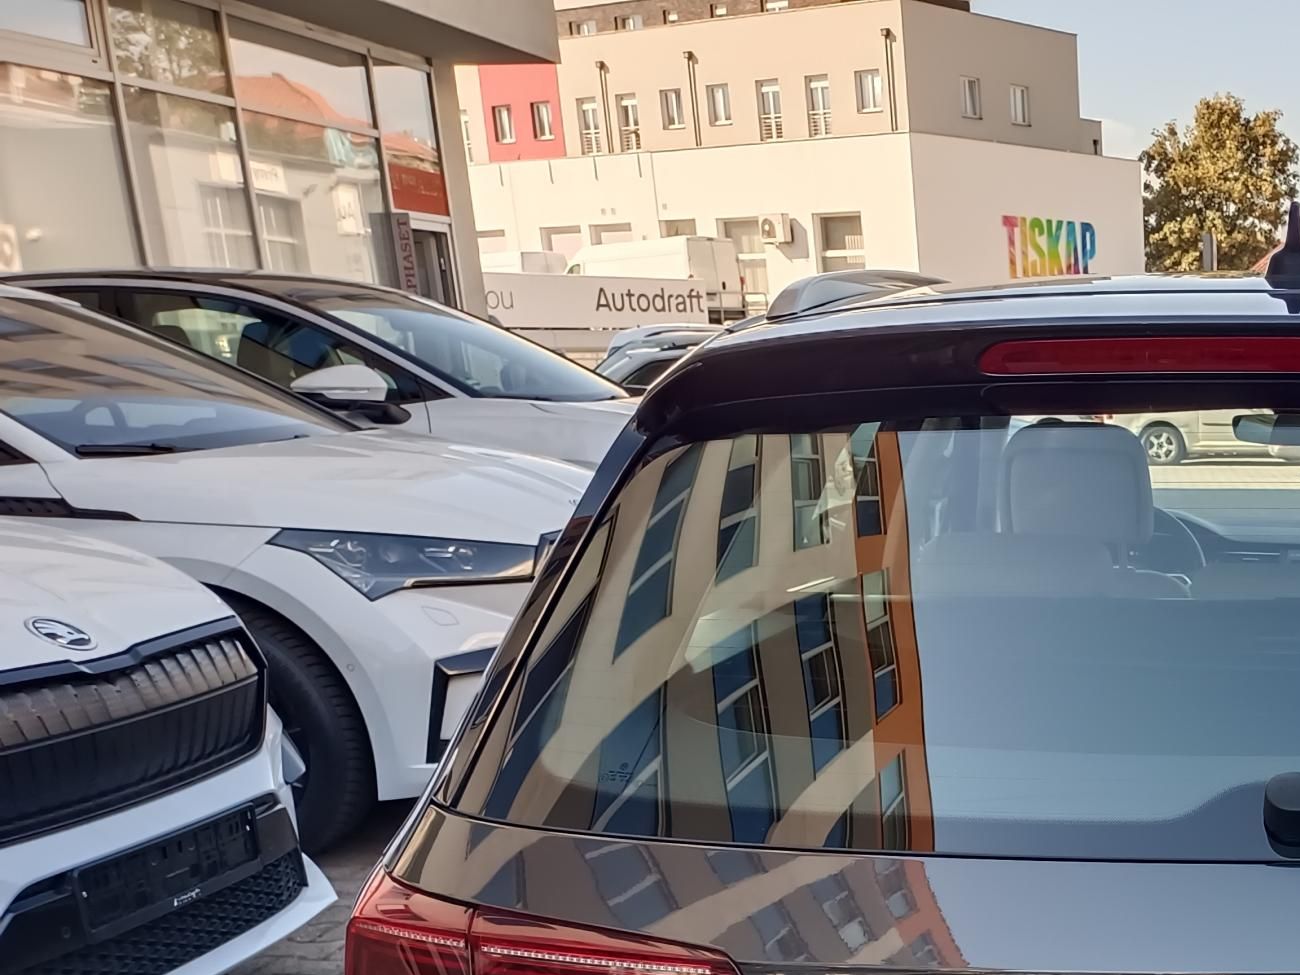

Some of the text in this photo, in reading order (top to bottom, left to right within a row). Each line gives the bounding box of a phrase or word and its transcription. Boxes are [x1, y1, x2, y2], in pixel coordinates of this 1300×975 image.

[397, 217, 419, 295] PHASET
[1002, 215, 1096, 279] TISKAP
[595, 287, 705, 313] Autodraft
